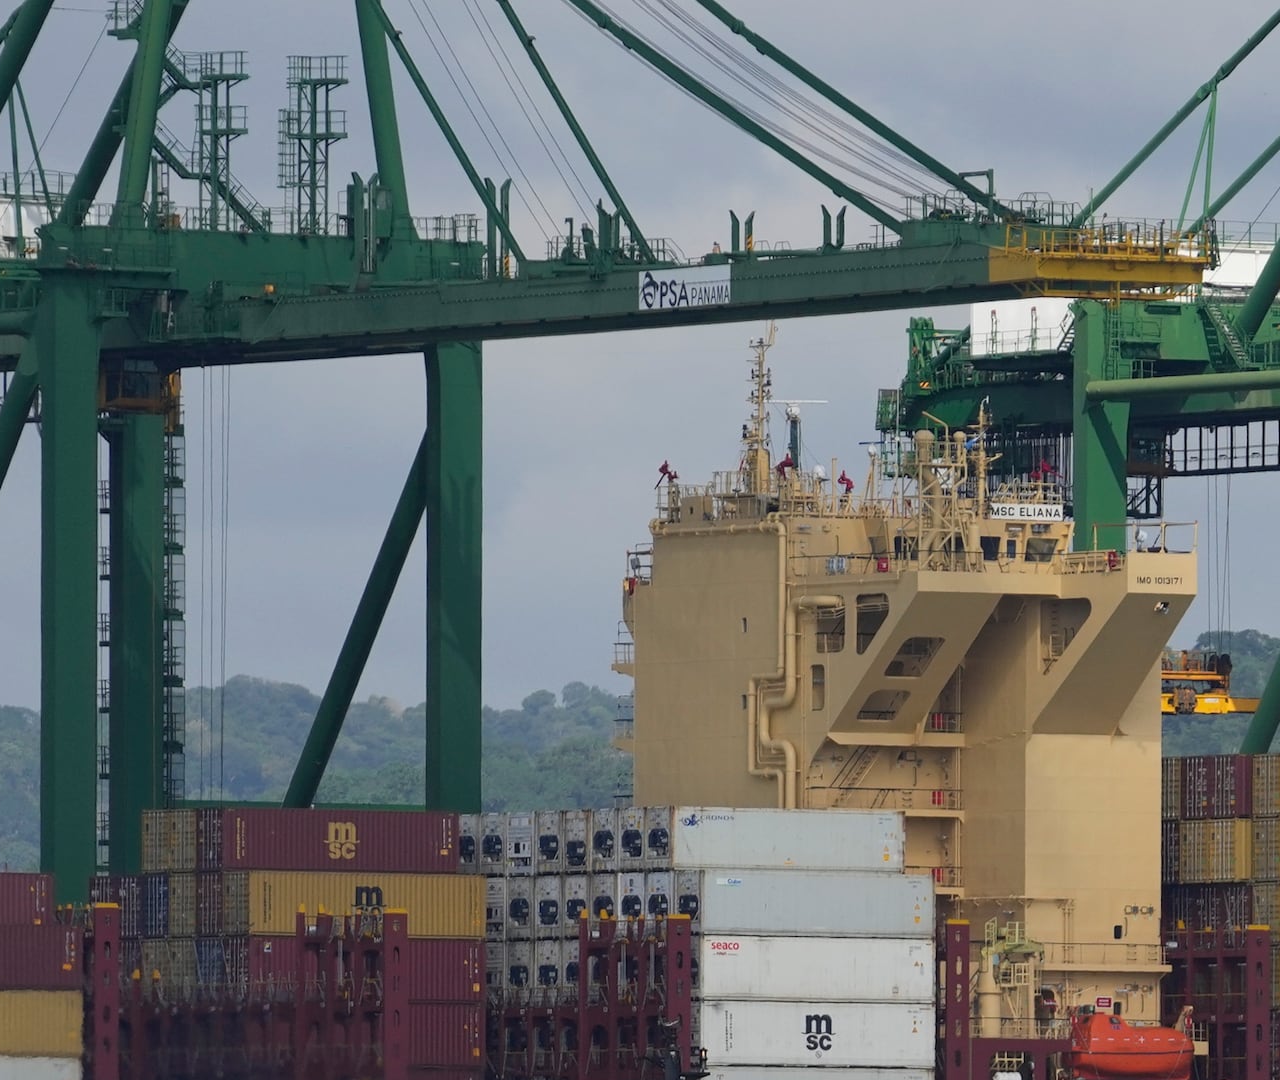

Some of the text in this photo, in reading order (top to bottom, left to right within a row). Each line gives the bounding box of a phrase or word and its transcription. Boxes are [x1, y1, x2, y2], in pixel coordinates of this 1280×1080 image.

[660, 280, 730, 308] PSA PANAMA
[991, 506, 1060, 518] MSC ELIANA
[1136, 576, 1151, 585] IMO
[711, 942, 740, 950] seaco
